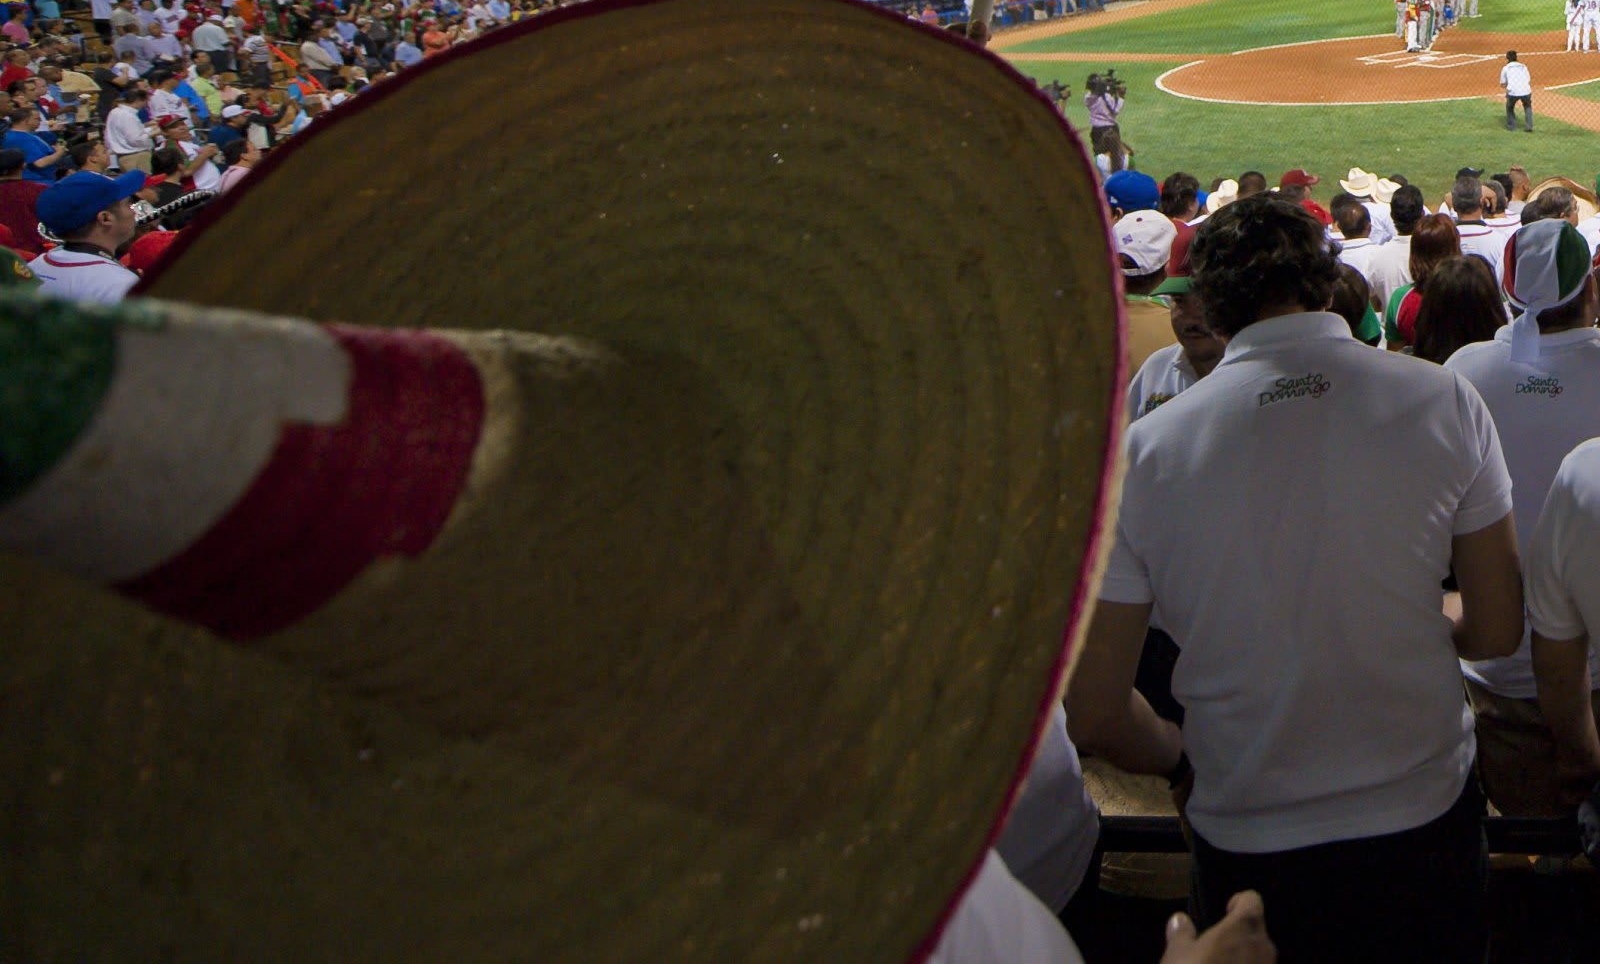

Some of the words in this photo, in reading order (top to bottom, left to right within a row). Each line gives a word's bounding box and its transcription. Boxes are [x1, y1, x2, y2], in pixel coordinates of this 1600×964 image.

[1276, 373, 1323, 390] Santo
[1528, 376, 1559, 386] Santo
[1259, 381, 1331, 406] Domingo
[1515, 383, 1564, 397] Domingo
